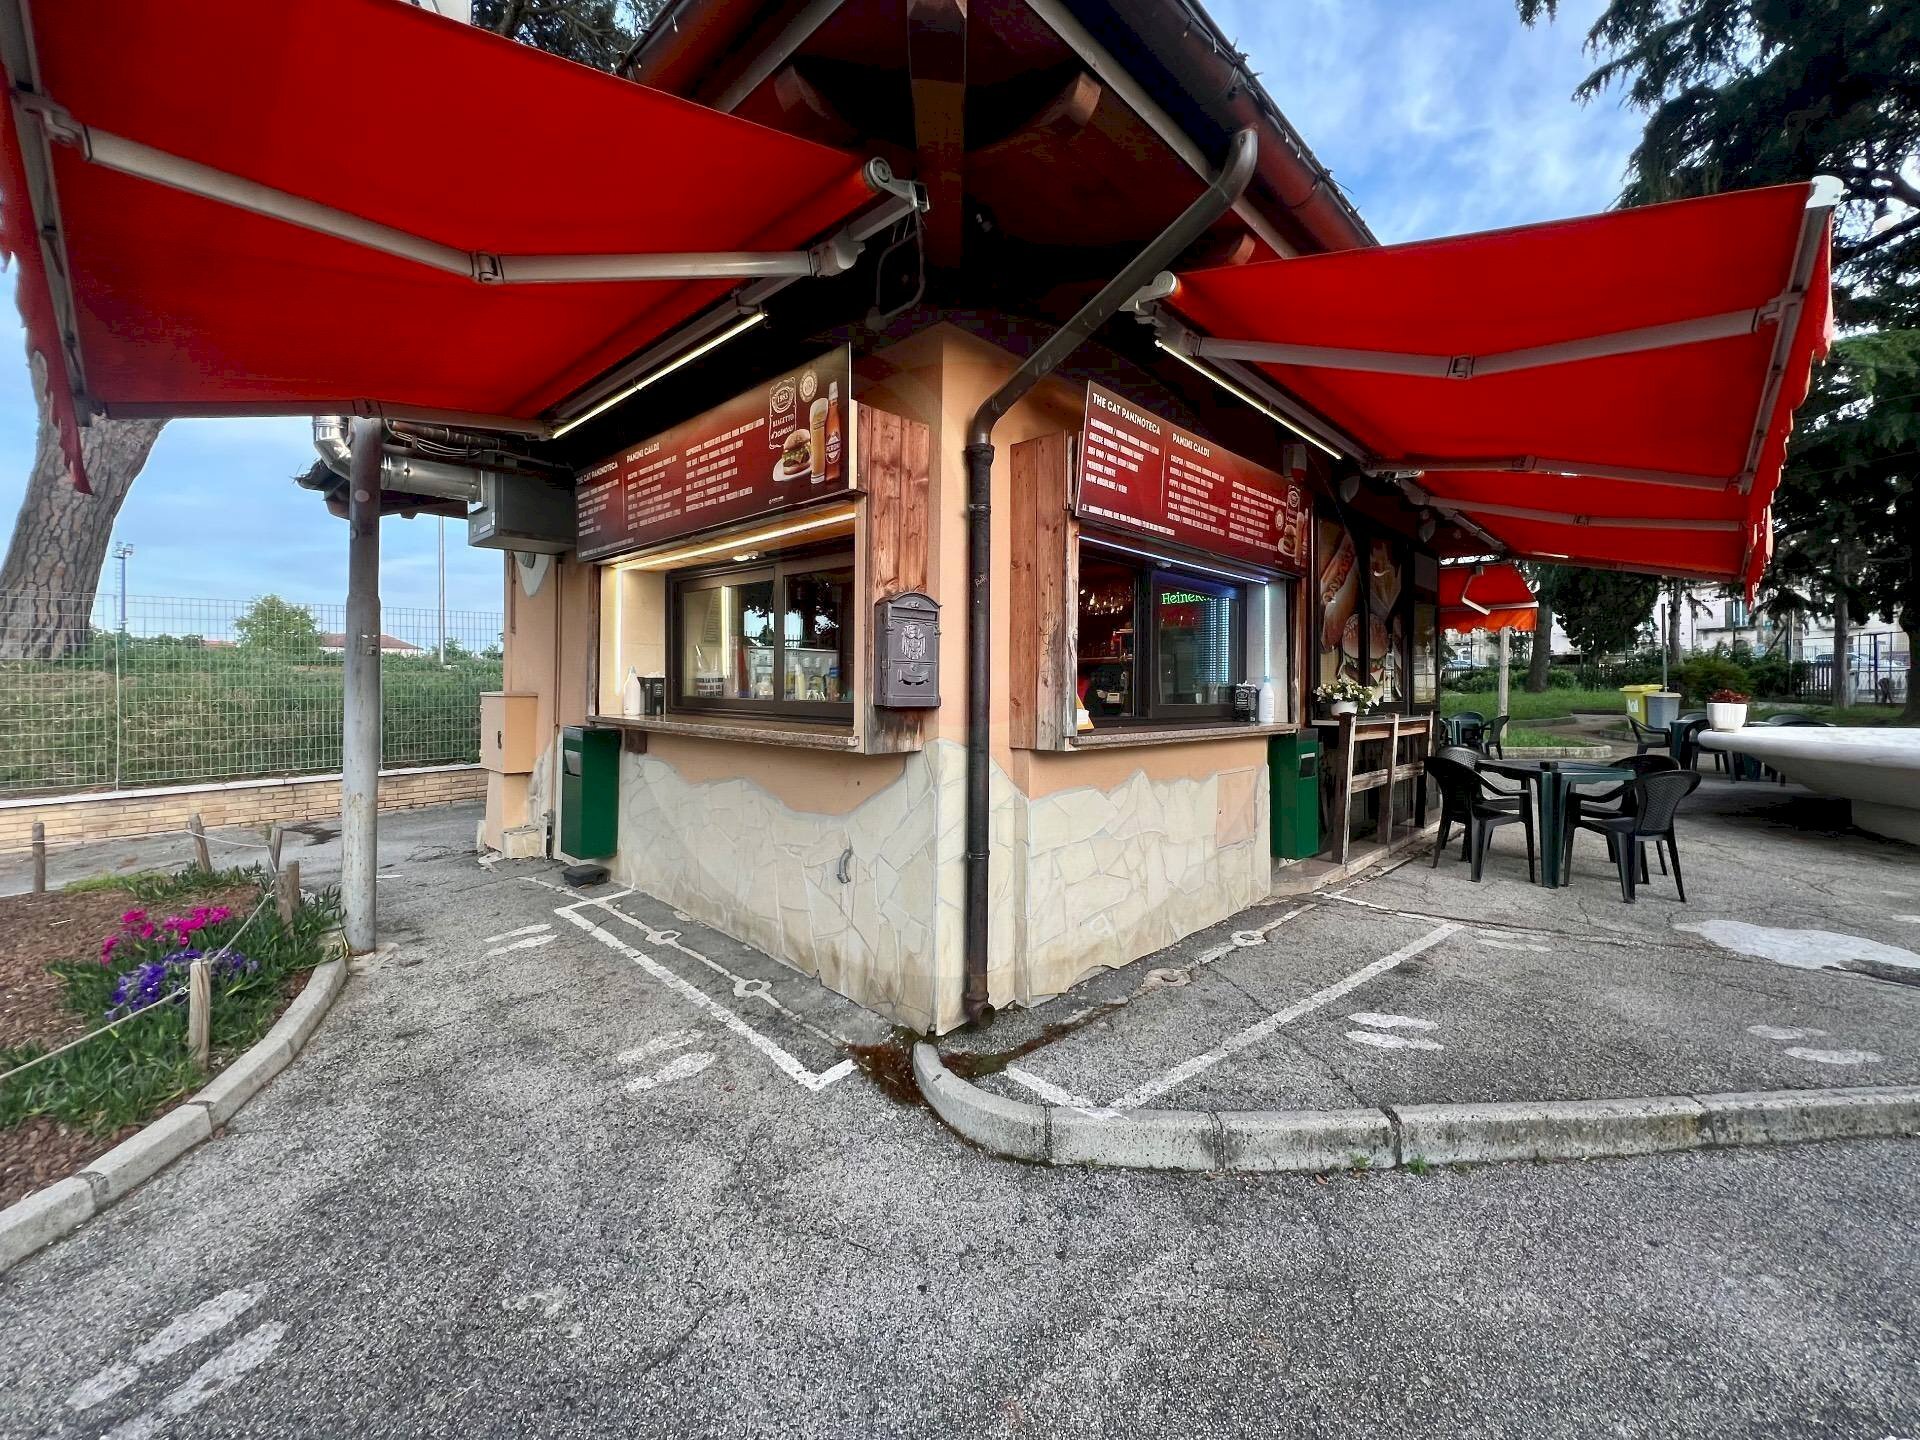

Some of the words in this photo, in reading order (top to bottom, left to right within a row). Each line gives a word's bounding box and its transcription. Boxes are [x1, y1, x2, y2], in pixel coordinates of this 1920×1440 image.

[1092, 392, 1107, 409] THE
[1107, 401, 1121, 415] CAT
[1121, 408, 1161, 436] PANINOTECA
[626, 449, 644, 463] PANINI
[643, 442, 660, 456] CALDI
[1172, 432, 1193, 450] PANINI
[1193, 441, 1211, 458] CALDI
[591, 461, 619, 478] PANINOTECA
